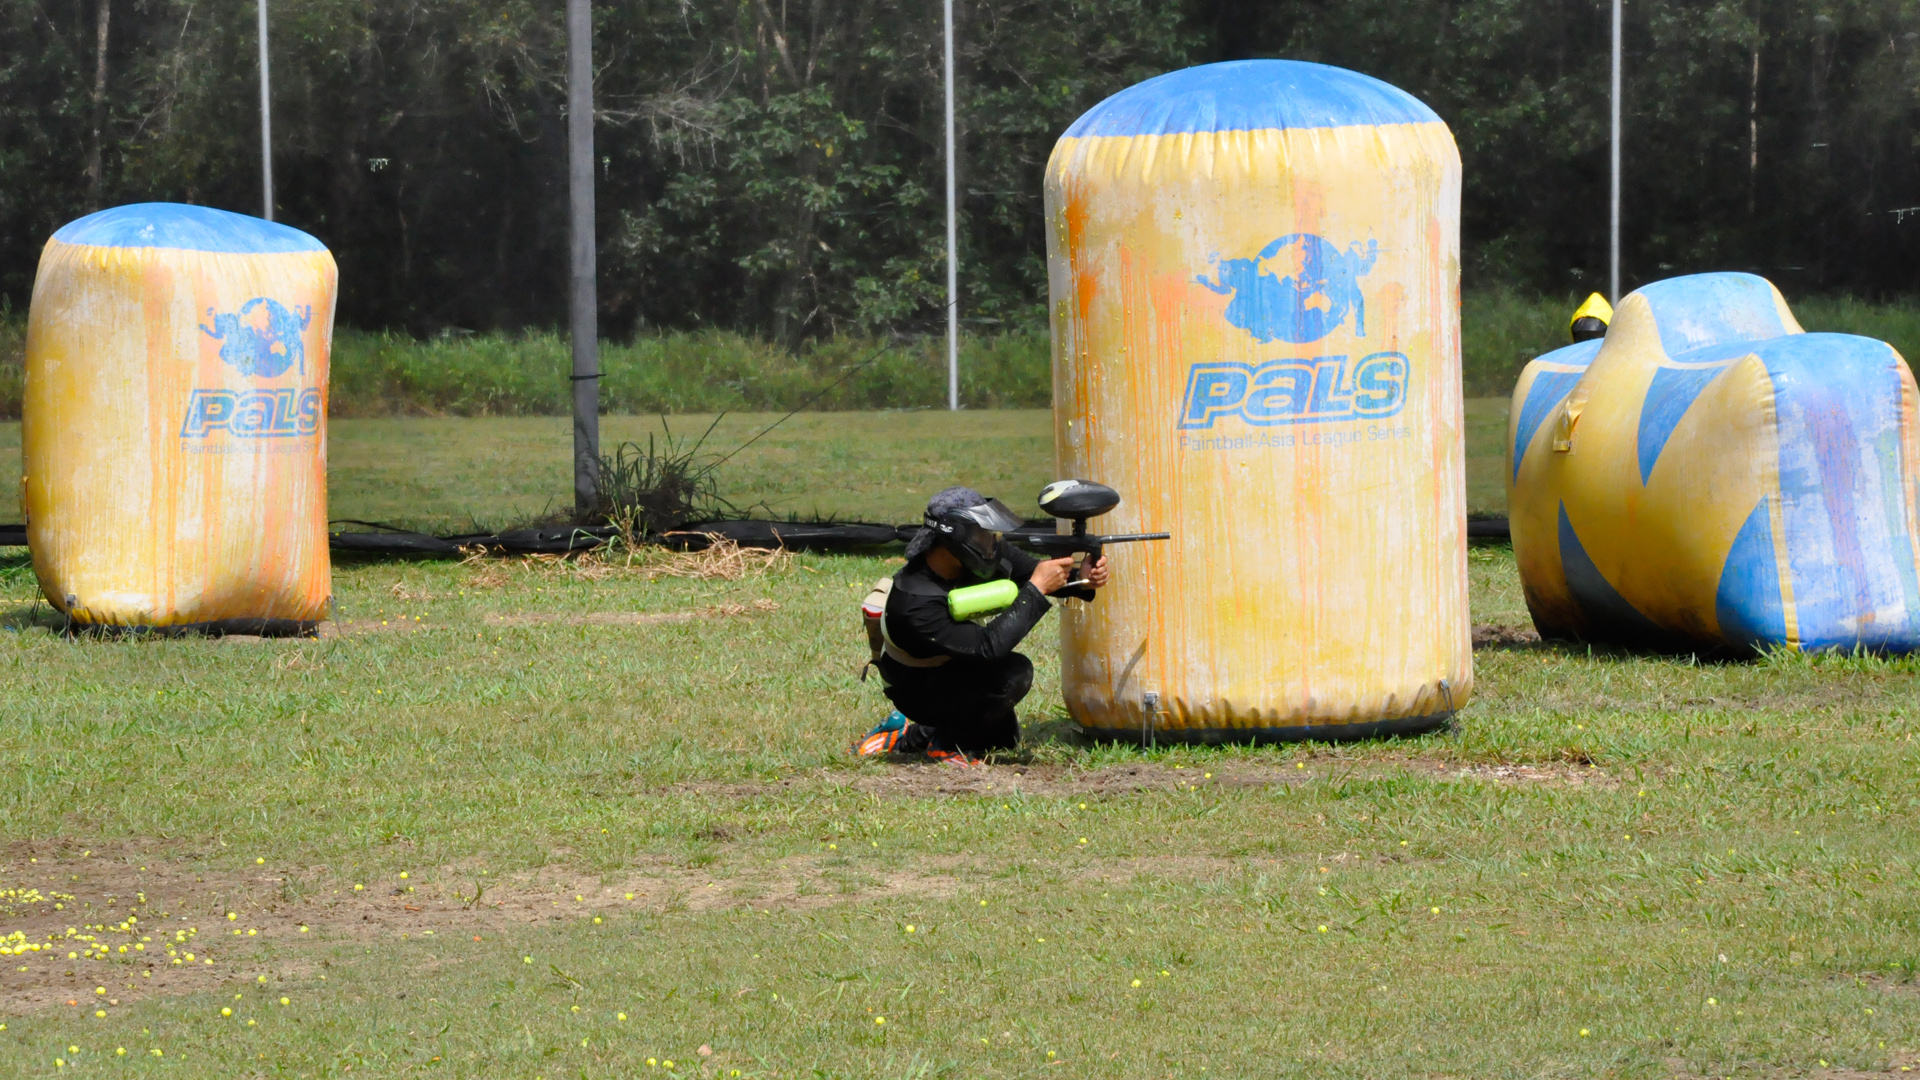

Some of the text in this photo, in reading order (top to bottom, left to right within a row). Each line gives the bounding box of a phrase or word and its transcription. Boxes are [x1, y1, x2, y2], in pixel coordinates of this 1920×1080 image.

[1179, 425, 1411, 451] Paintball-Asia League Series
